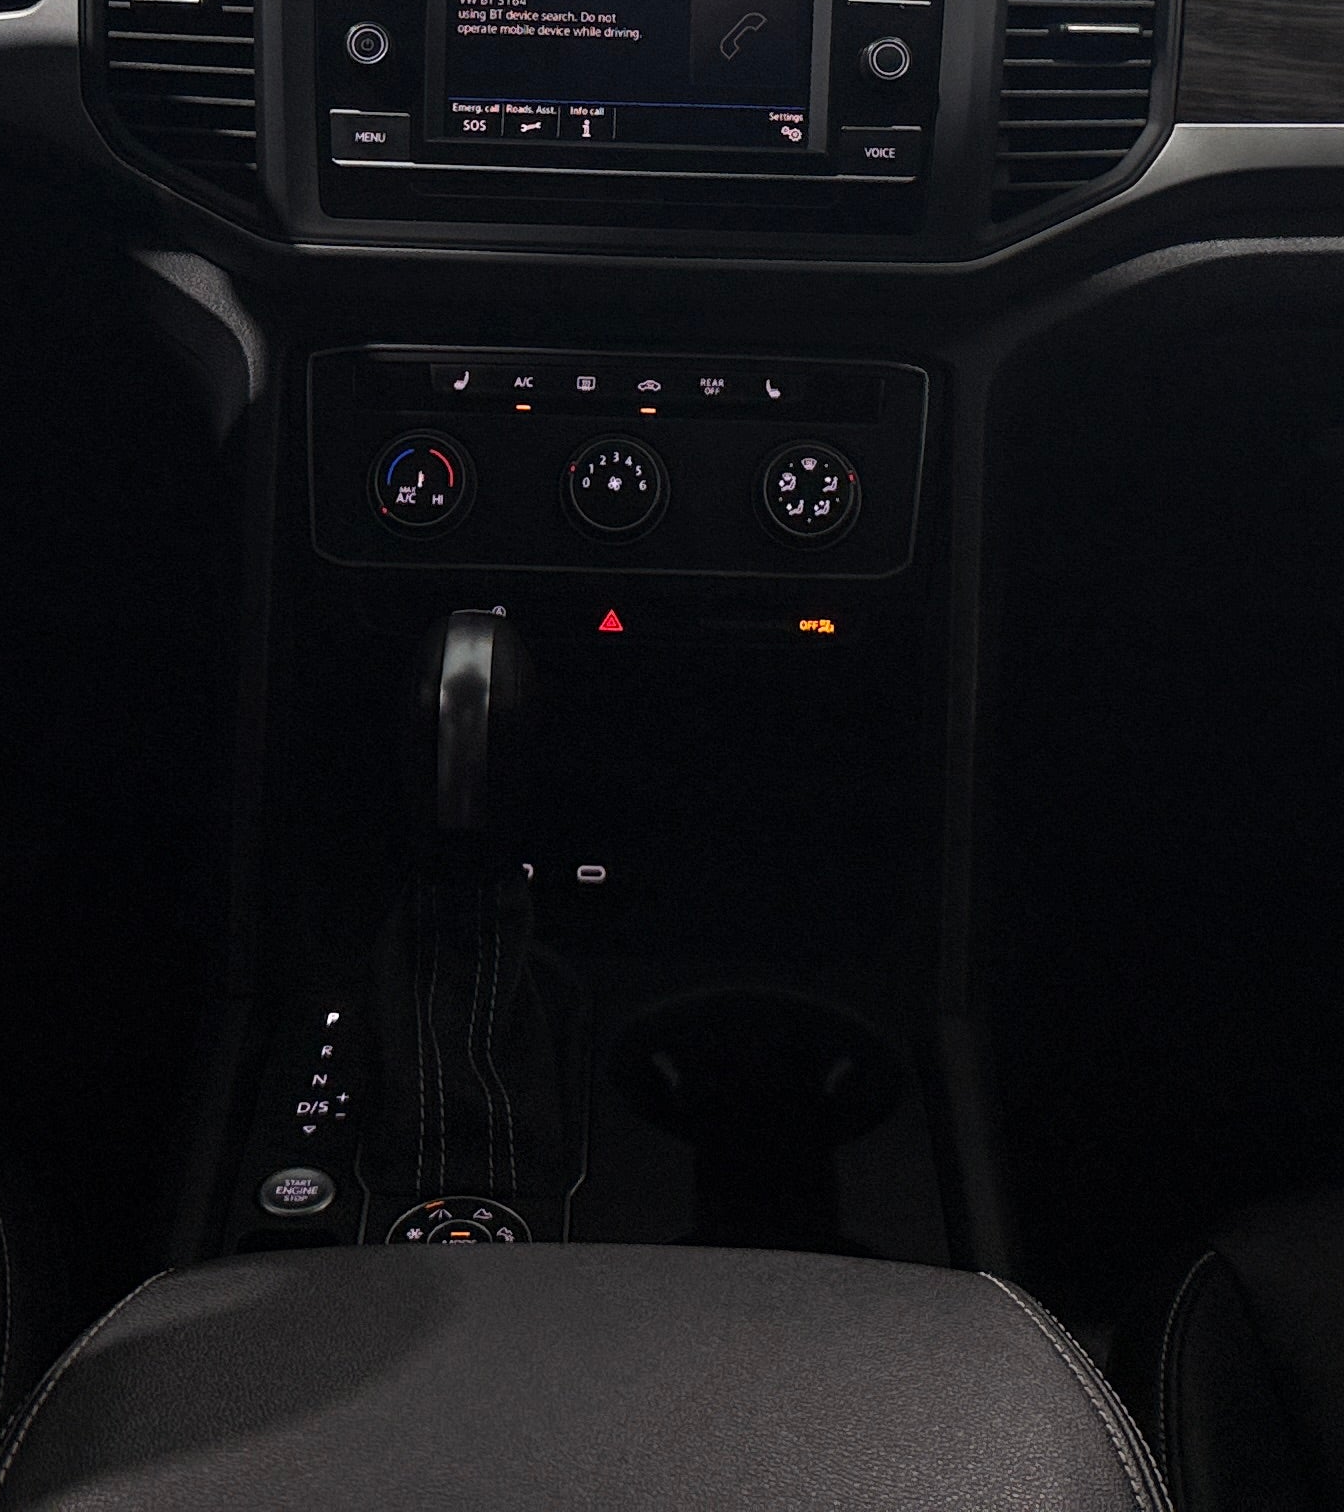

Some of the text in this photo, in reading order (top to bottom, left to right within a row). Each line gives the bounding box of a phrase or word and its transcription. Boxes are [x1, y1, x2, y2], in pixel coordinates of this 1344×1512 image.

[458, 8, 617, 23] using BT device search. Do not
[457, 23, 643, 41] operate mobile device while driving.
[452, 102, 500, 114] Emerg. call
[506, 103, 557, 115] Roads. Asst.
[570, 106, 605, 116] Info call
[768, 112, 804, 123] Settings
[463, 119, 487, 131] SOS
[355, 131, 387, 143] MENU
[864, 147, 896, 159] VOICE
[513, 376, 534, 388] A/C
[699, 378, 725, 387] REAR
[704, 386, 720, 395] OFF
[599, 454, 607, 466] 2
[613, 451, 620, 463] 3
[625, 455, 633, 467] 4
[588, 463, 595, 474] 1
[635, 465, 642, 477] 5
[582, 476, 591, 488] 0
[639, 479, 647, 491] 6
[399, 486, 416, 494] MAX
[396, 492, 416, 504] A/C
[431, 494, 444, 505] HI
[799, 619, 819, 631] OFF
[326, 1012, 340, 1026] P
[321, 1045, 333, 1058] R
[312, 1074, 327, 1087] N
[296, 1100, 329, 1114] D/S
[284, 1179, 311, 1187] START
[275, 1186, 319, 1195] ENGINE
[283, 1194, 308, 1202] STOP
